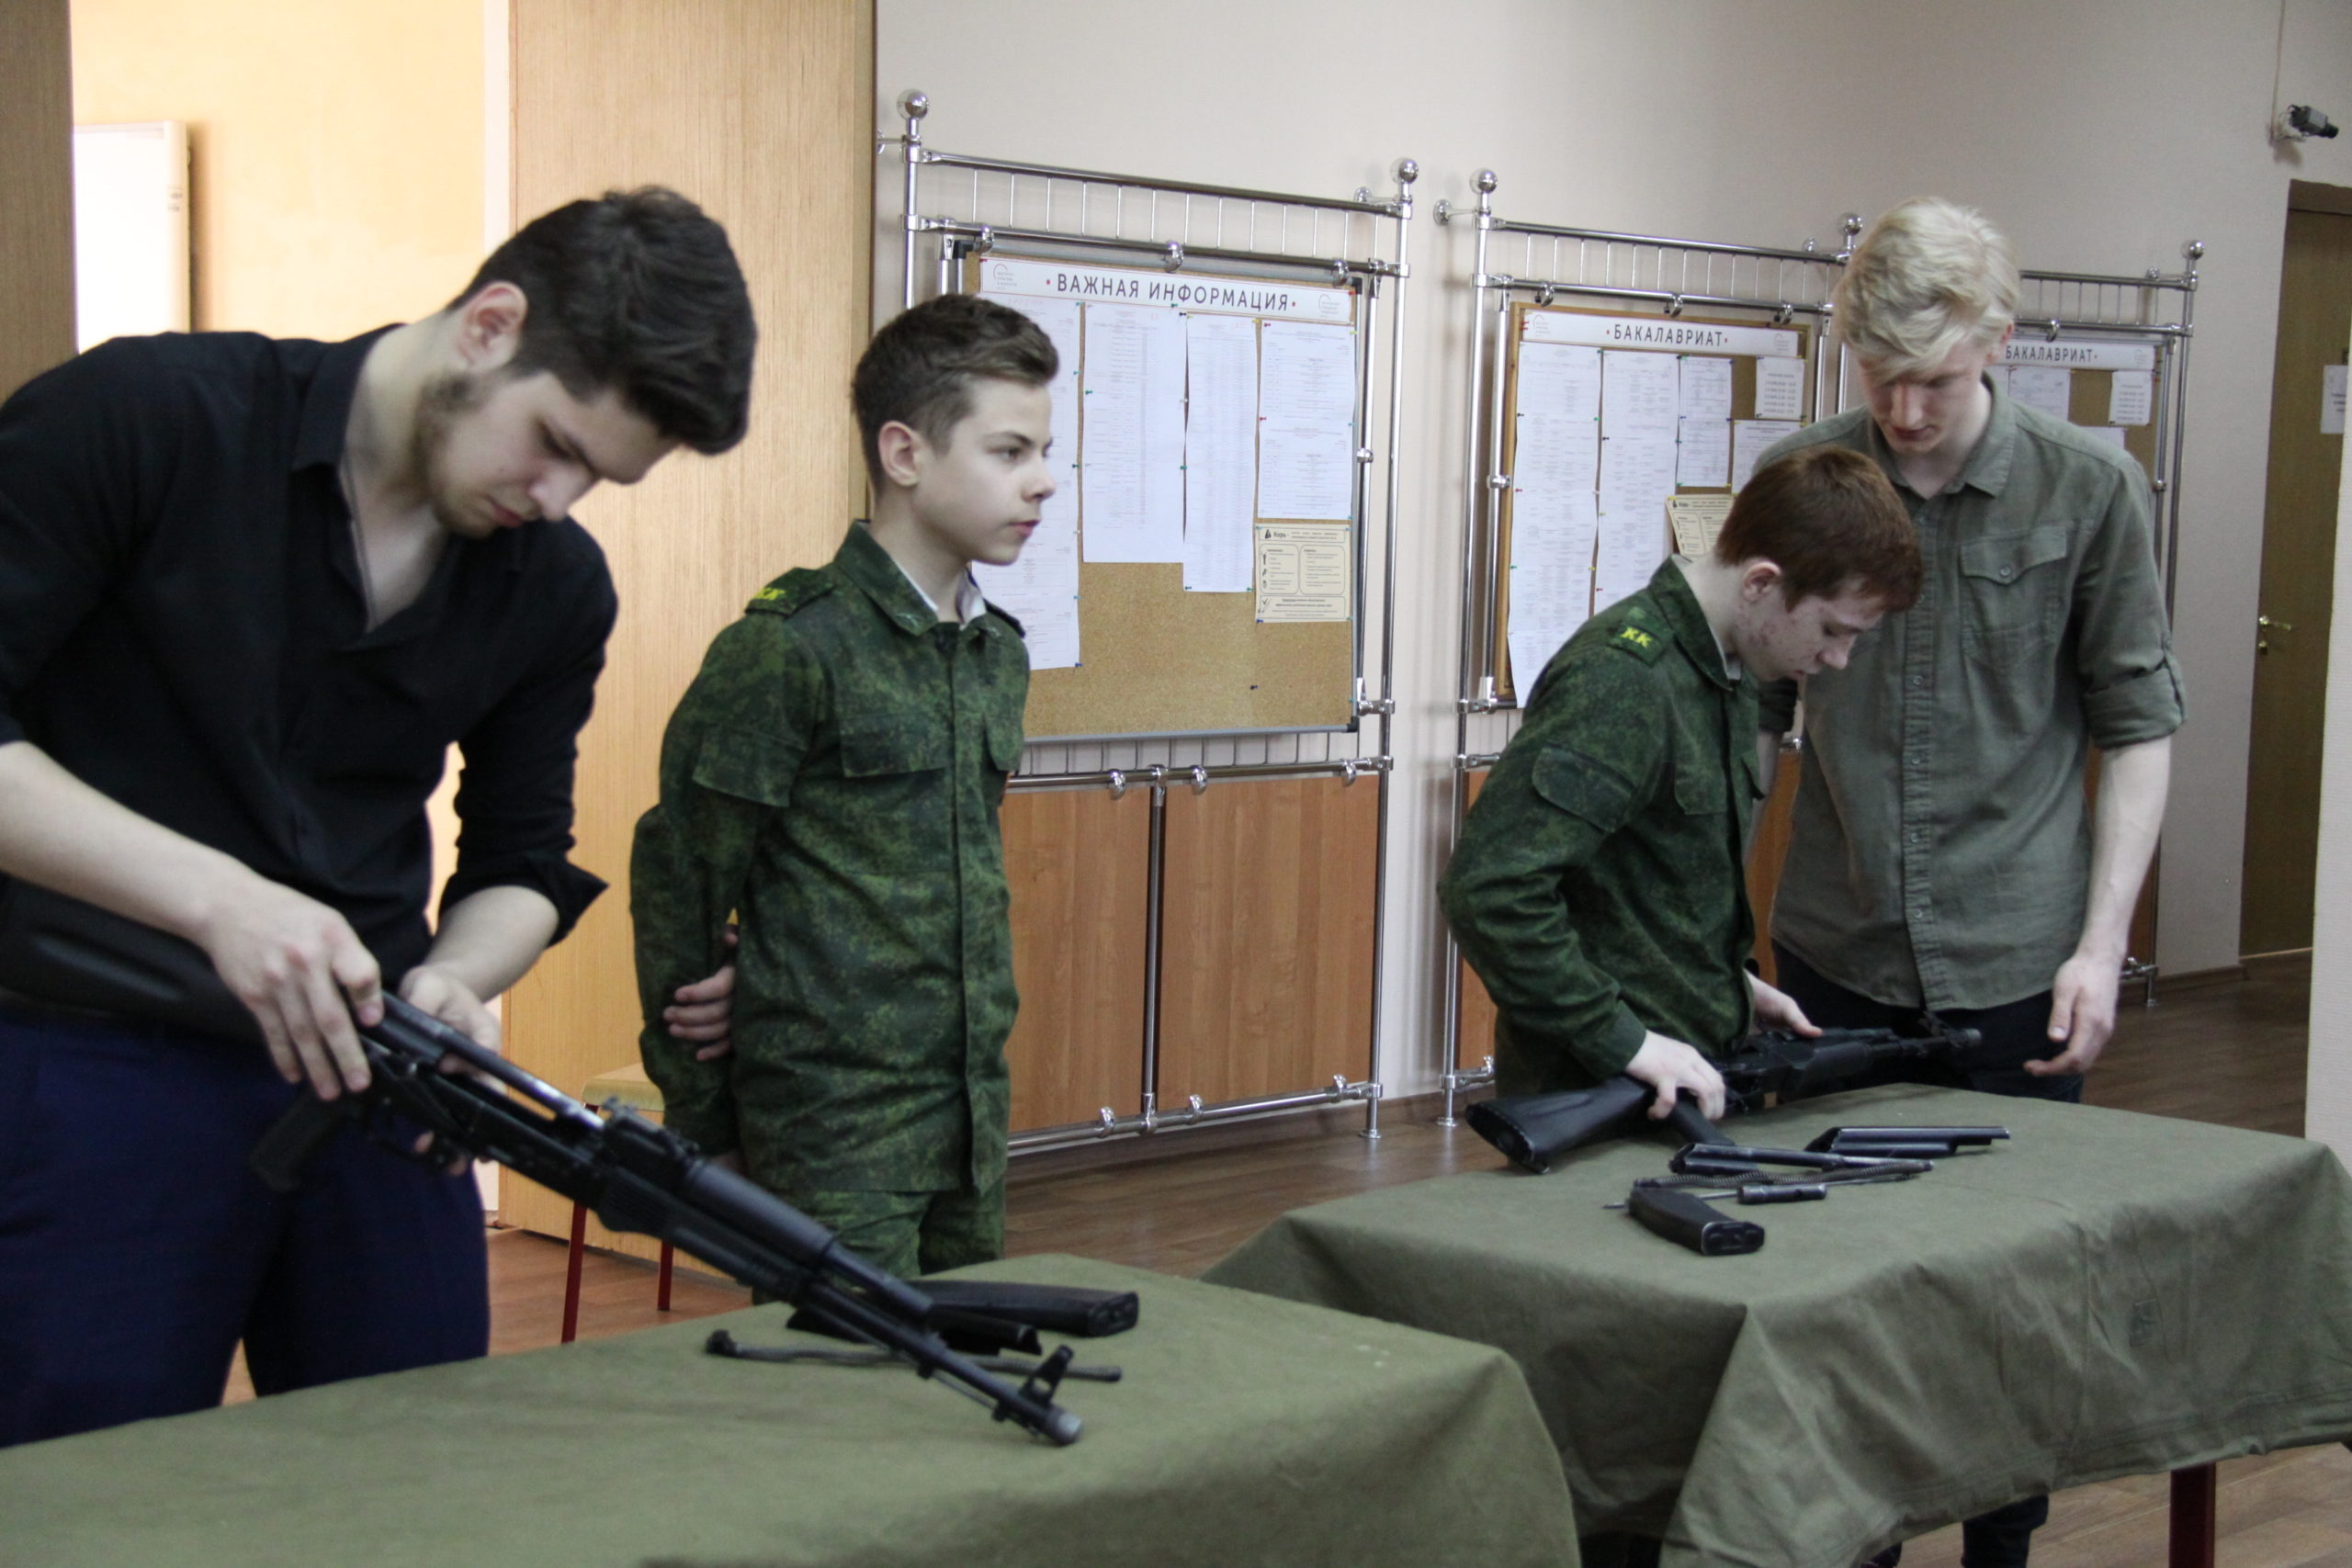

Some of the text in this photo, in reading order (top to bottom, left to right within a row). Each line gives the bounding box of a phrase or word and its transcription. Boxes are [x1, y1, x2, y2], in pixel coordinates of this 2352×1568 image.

[1057, 273, 1139, 298] ВАЖНАЯ
[1148, 281, 1288, 312] ИНФОРМАЦИЯ
[1613, 323, 1723, 346] БАКАЛАВРИАТ
[2005, 344, 2093, 362] БАКАЛАВРИАТ
